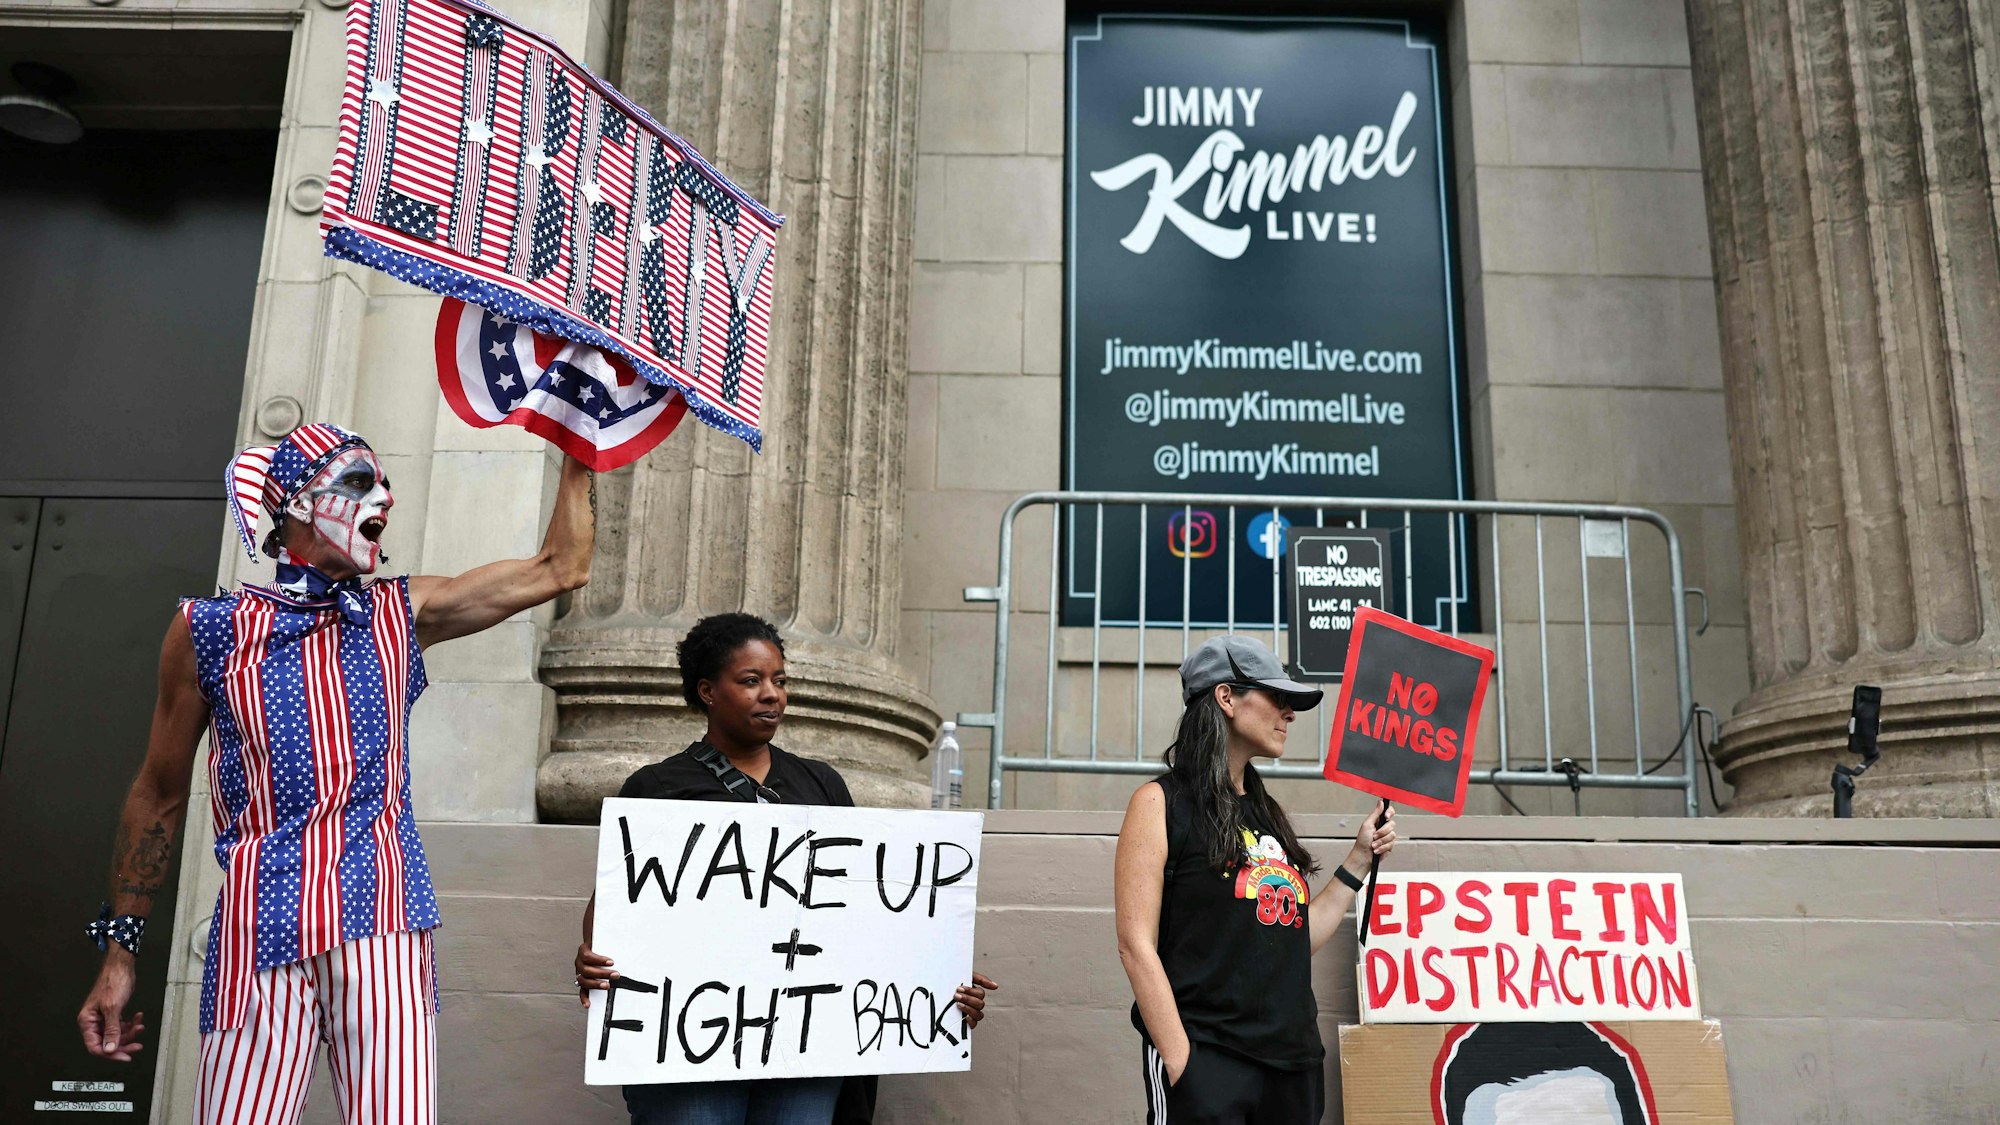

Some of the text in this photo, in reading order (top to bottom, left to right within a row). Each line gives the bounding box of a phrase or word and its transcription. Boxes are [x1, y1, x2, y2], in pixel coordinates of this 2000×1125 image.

[1132, 86, 1263, 127] JIMMY
[1090, 90, 1418, 260] Kimmel
[347, 0, 771, 406] LIBERTY
[1266, 211, 1378, 243] LIVE!
[1101, 338, 1422, 375] JimmyKimmelLive.com
[1125, 389, 1405, 427] @JimmyKimmelLive
[1153, 442, 1379, 480] @JimmyKimmel
[1326, 545, 1348, 565] NO
[1297, 566, 1382, 587] TRESPASSING
[1308, 598, 1338, 612] LAMC
[1309, 616, 1331, 629] 602
[1332, 616, 1351, 630] (10)
[1349, 698, 1458, 762] KINGS
[618, 816, 973, 918] WAKE UP
[1247, 866, 1302, 895] Made in the
[1366, 879, 1677, 945] EPSTEIN
[1366, 943, 1692, 1011] DISTRACTION
[598, 975, 843, 1069] FIGHT
[71, 1102, 107, 1110] SWINGS
